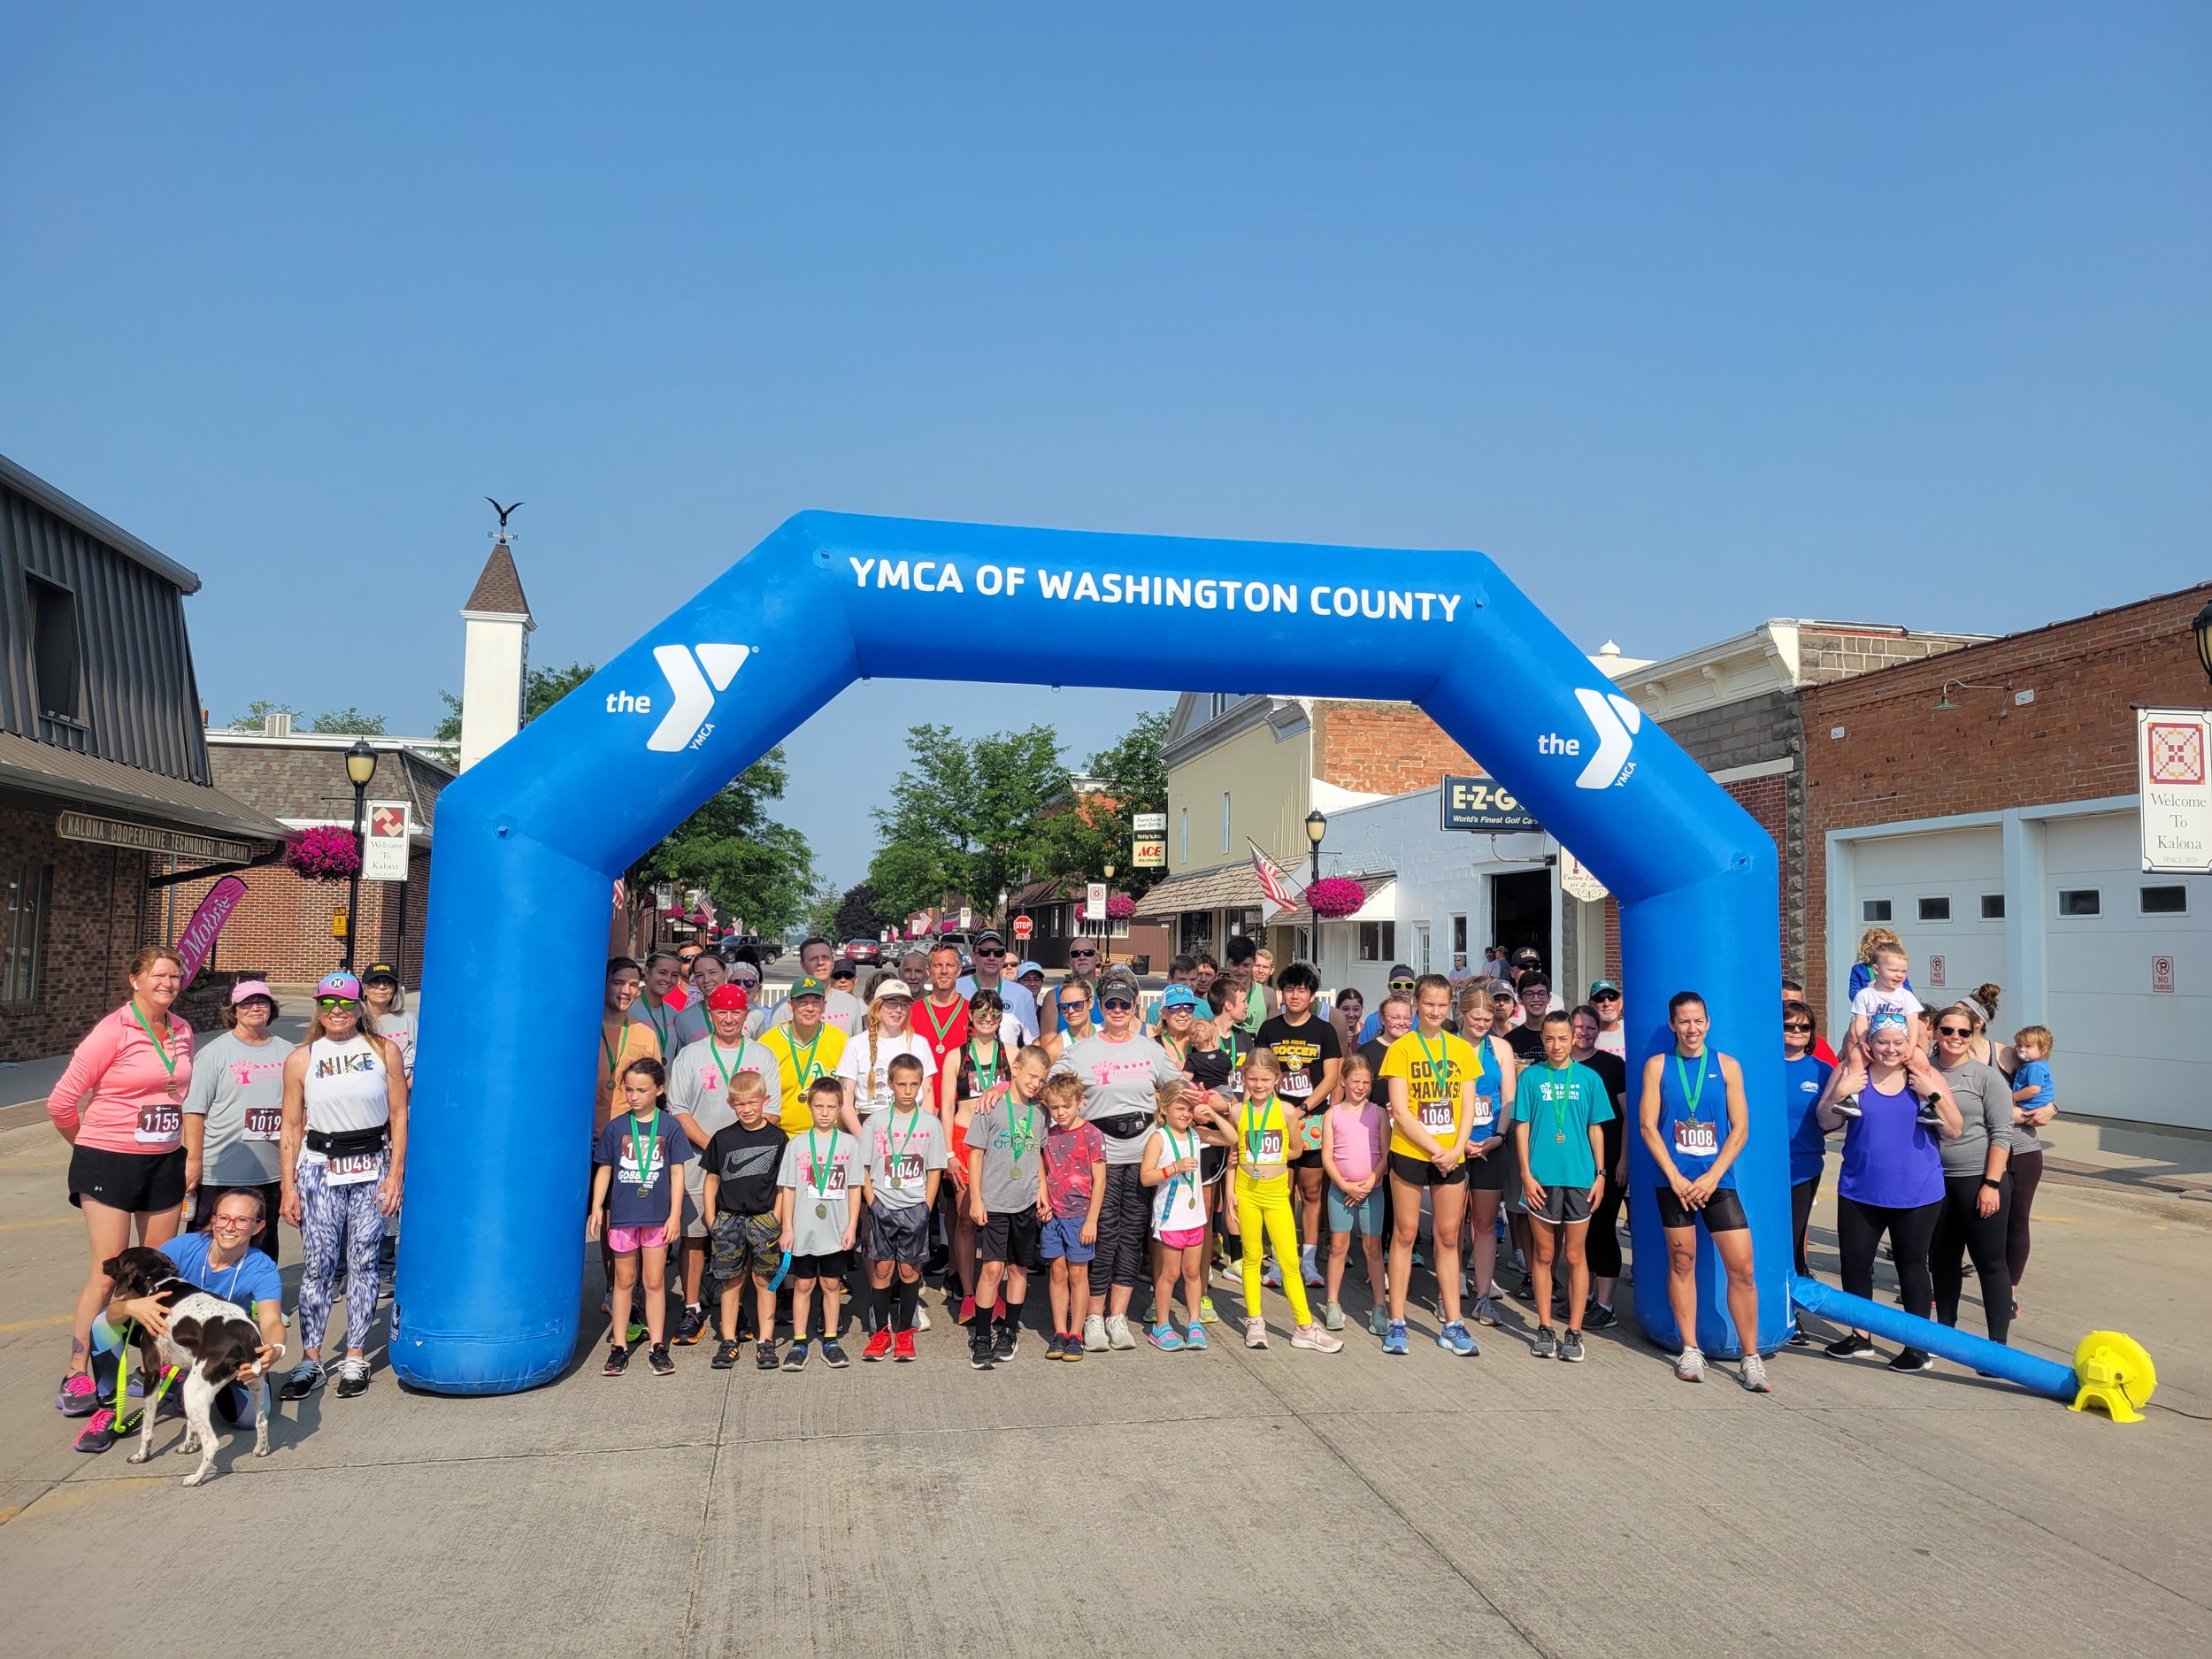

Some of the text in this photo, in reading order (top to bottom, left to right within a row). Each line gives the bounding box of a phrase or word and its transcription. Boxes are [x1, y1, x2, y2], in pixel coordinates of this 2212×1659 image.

[849, 557, 1461, 622] YMCA OF WASHINGTON COUNTY
[606, 690, 651, 713] the
[688, 723, 715, 750] YMCA
[1538, 733, 1580, 756] the
[1615, 762, 1637, 787] YMCA
[1453, 785, 1517, 811] E-Z-G
[2150, 793, 2207, 807] Welcome
[2170, 815, 2187, 827] To
[67, 816, 249, 861] KALONA COOPERATIVE TECHNOLOGY COMPANY
[371, 841, 404, 849] Welcome
[2157, 835, 2202, 849] Kalona
[1138, 845, 1162, 856] ACE
[1272, 1046, 1317, 1056] SOCCER
[317, 1053, 374, 1078] NIKE
[1411, 1061, 1432, 1079] GO
[1283, 1075, 1309, 1091] 1100
[144, 1113, 179, 1131] 1155
[250, 1116, 281, 1131] 1019
[1422, 1108, 1451, 1125] 1068
[994, 1140, 1039, 1152] adas
[1680, 1129, 1713, 1146] 1008
[334, 1154, 371, 1174] 1048
[889, 1161, 919, 1178] 1046
[618, 1170, 659, 1181] GOBBER
